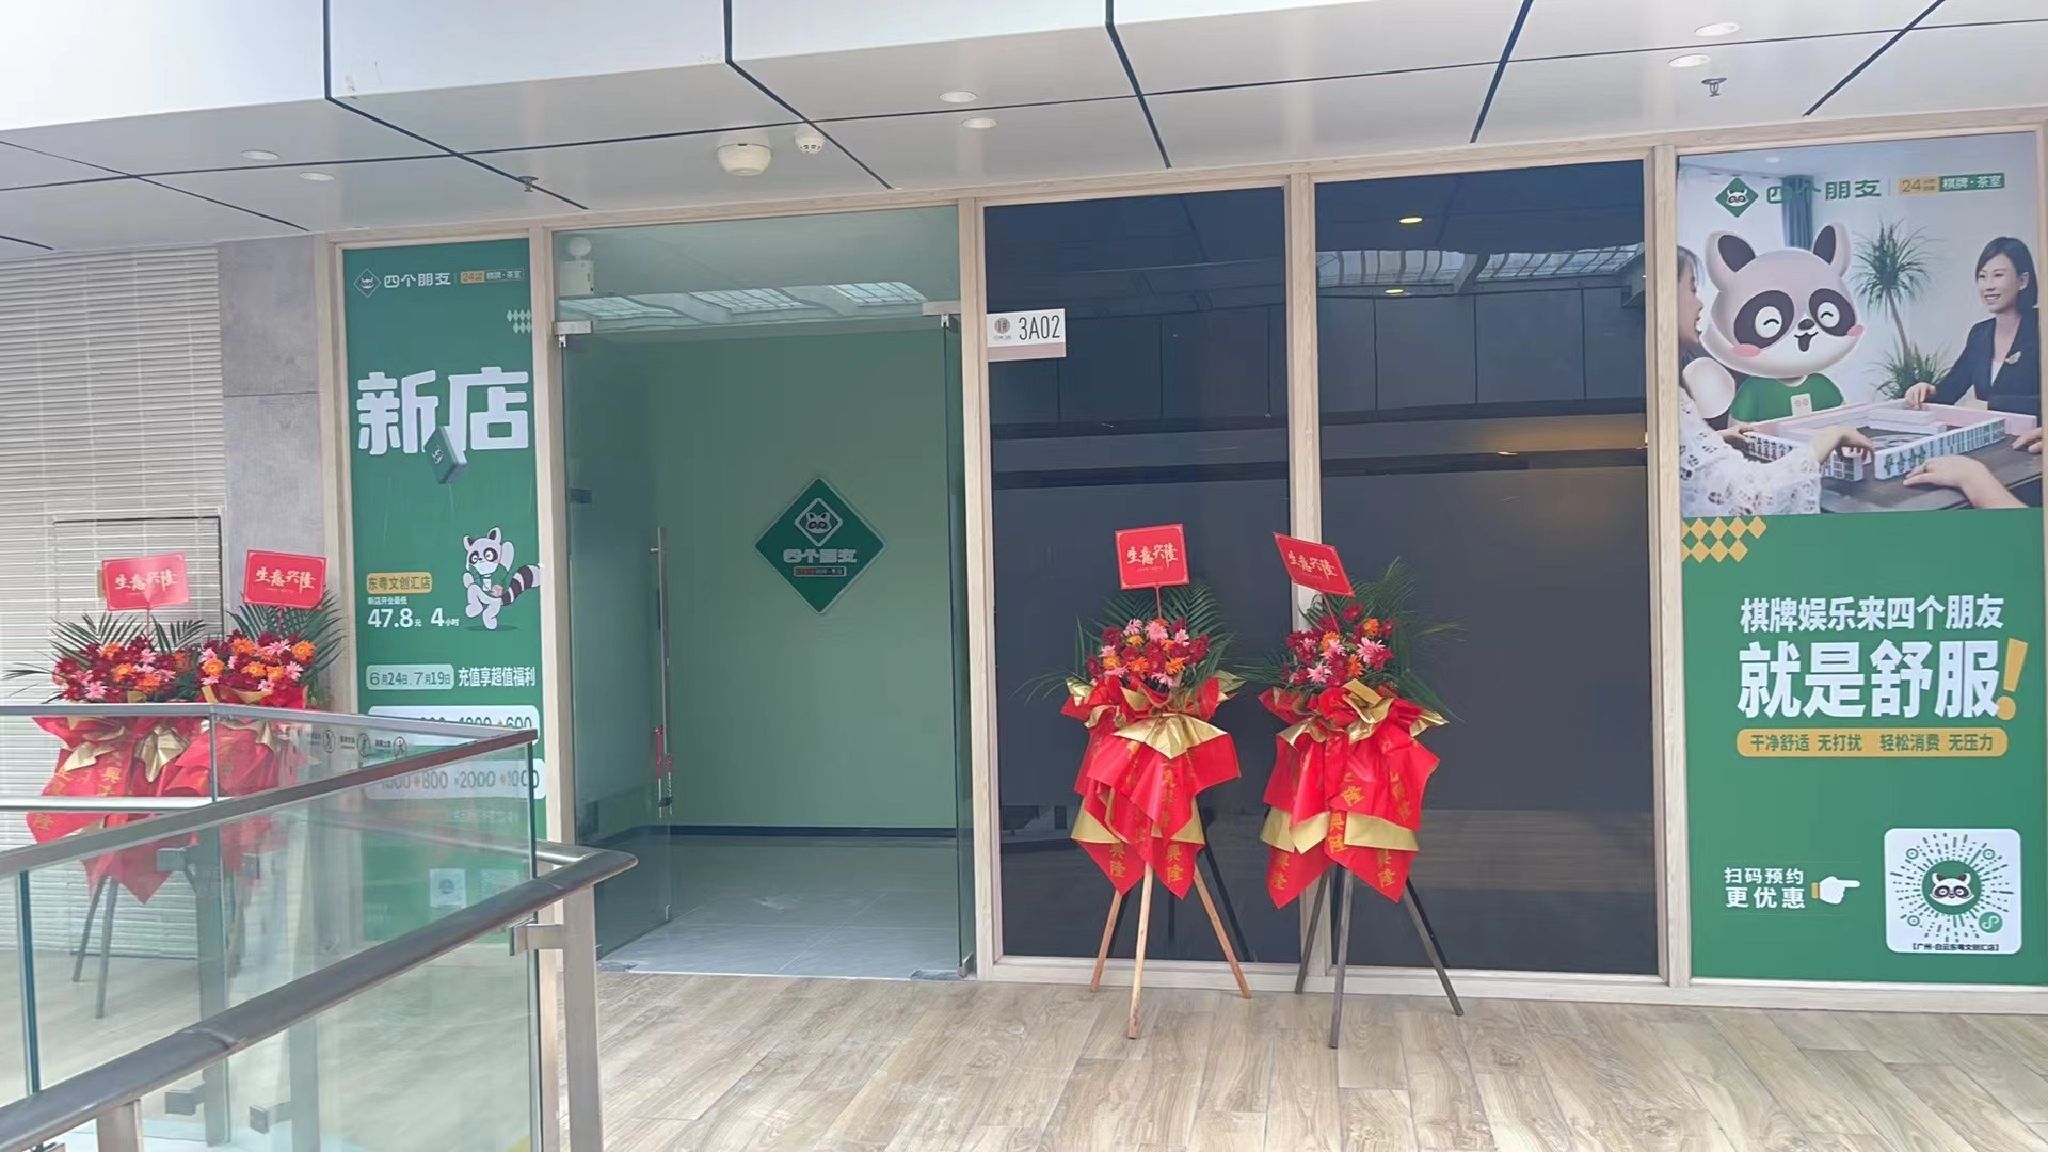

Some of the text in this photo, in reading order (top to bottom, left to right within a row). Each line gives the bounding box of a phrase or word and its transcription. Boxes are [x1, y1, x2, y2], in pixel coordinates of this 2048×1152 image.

[1019, 315, 1060, 340] 3A02
[357, 367, 529, 463] 新店
[1741, 594, 2004, 633] 棋牌娱乐来四个朋友
[458, 667, 536, 687] 充值享超值福利
[1750, 733, 1993, 752] 干净舒适 无打扰 轻松消费 无压力
[1725, 867, 1804, 885] 扫码预约
[1725, 886, 1805, 909] 更优惠
